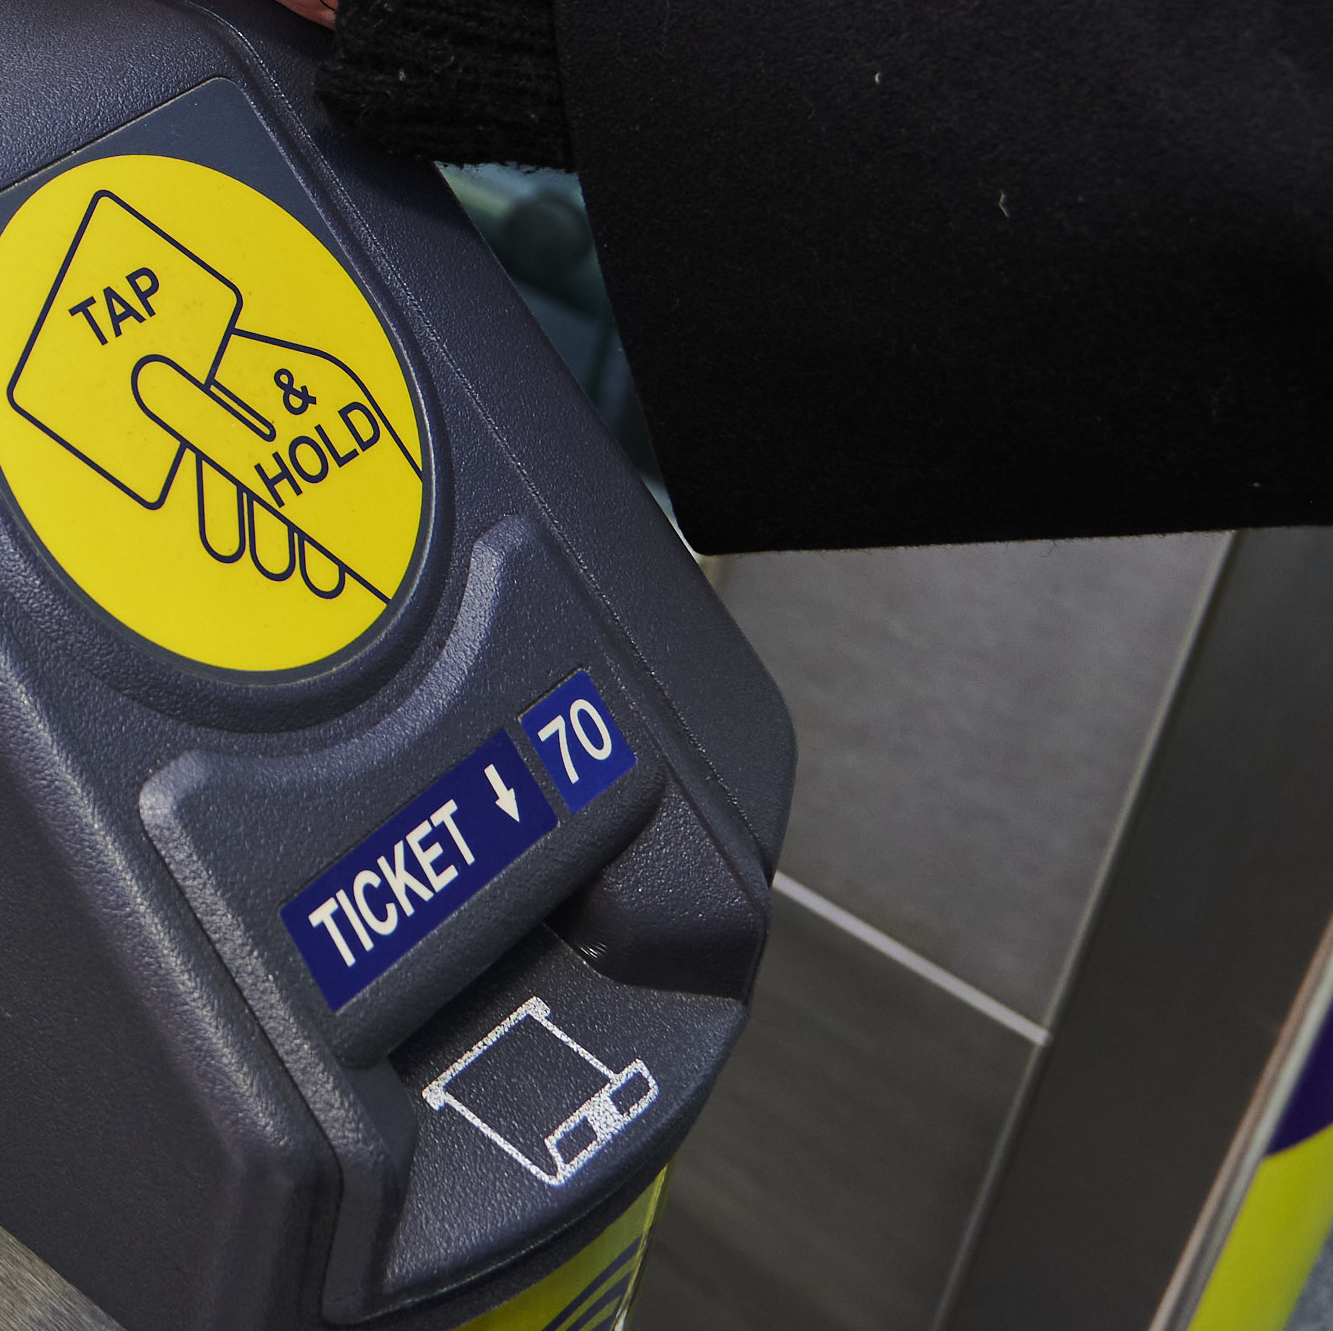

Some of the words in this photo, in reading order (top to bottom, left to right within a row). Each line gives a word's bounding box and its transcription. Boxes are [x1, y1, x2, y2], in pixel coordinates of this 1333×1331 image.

[68, 267, 160, 346] TAP
[273, 368, 317, 415] &
[254, 401, 381, 508] HOLD
[537, 699, 612, 784] 70
[308, 799, 475, 967] TICKET
